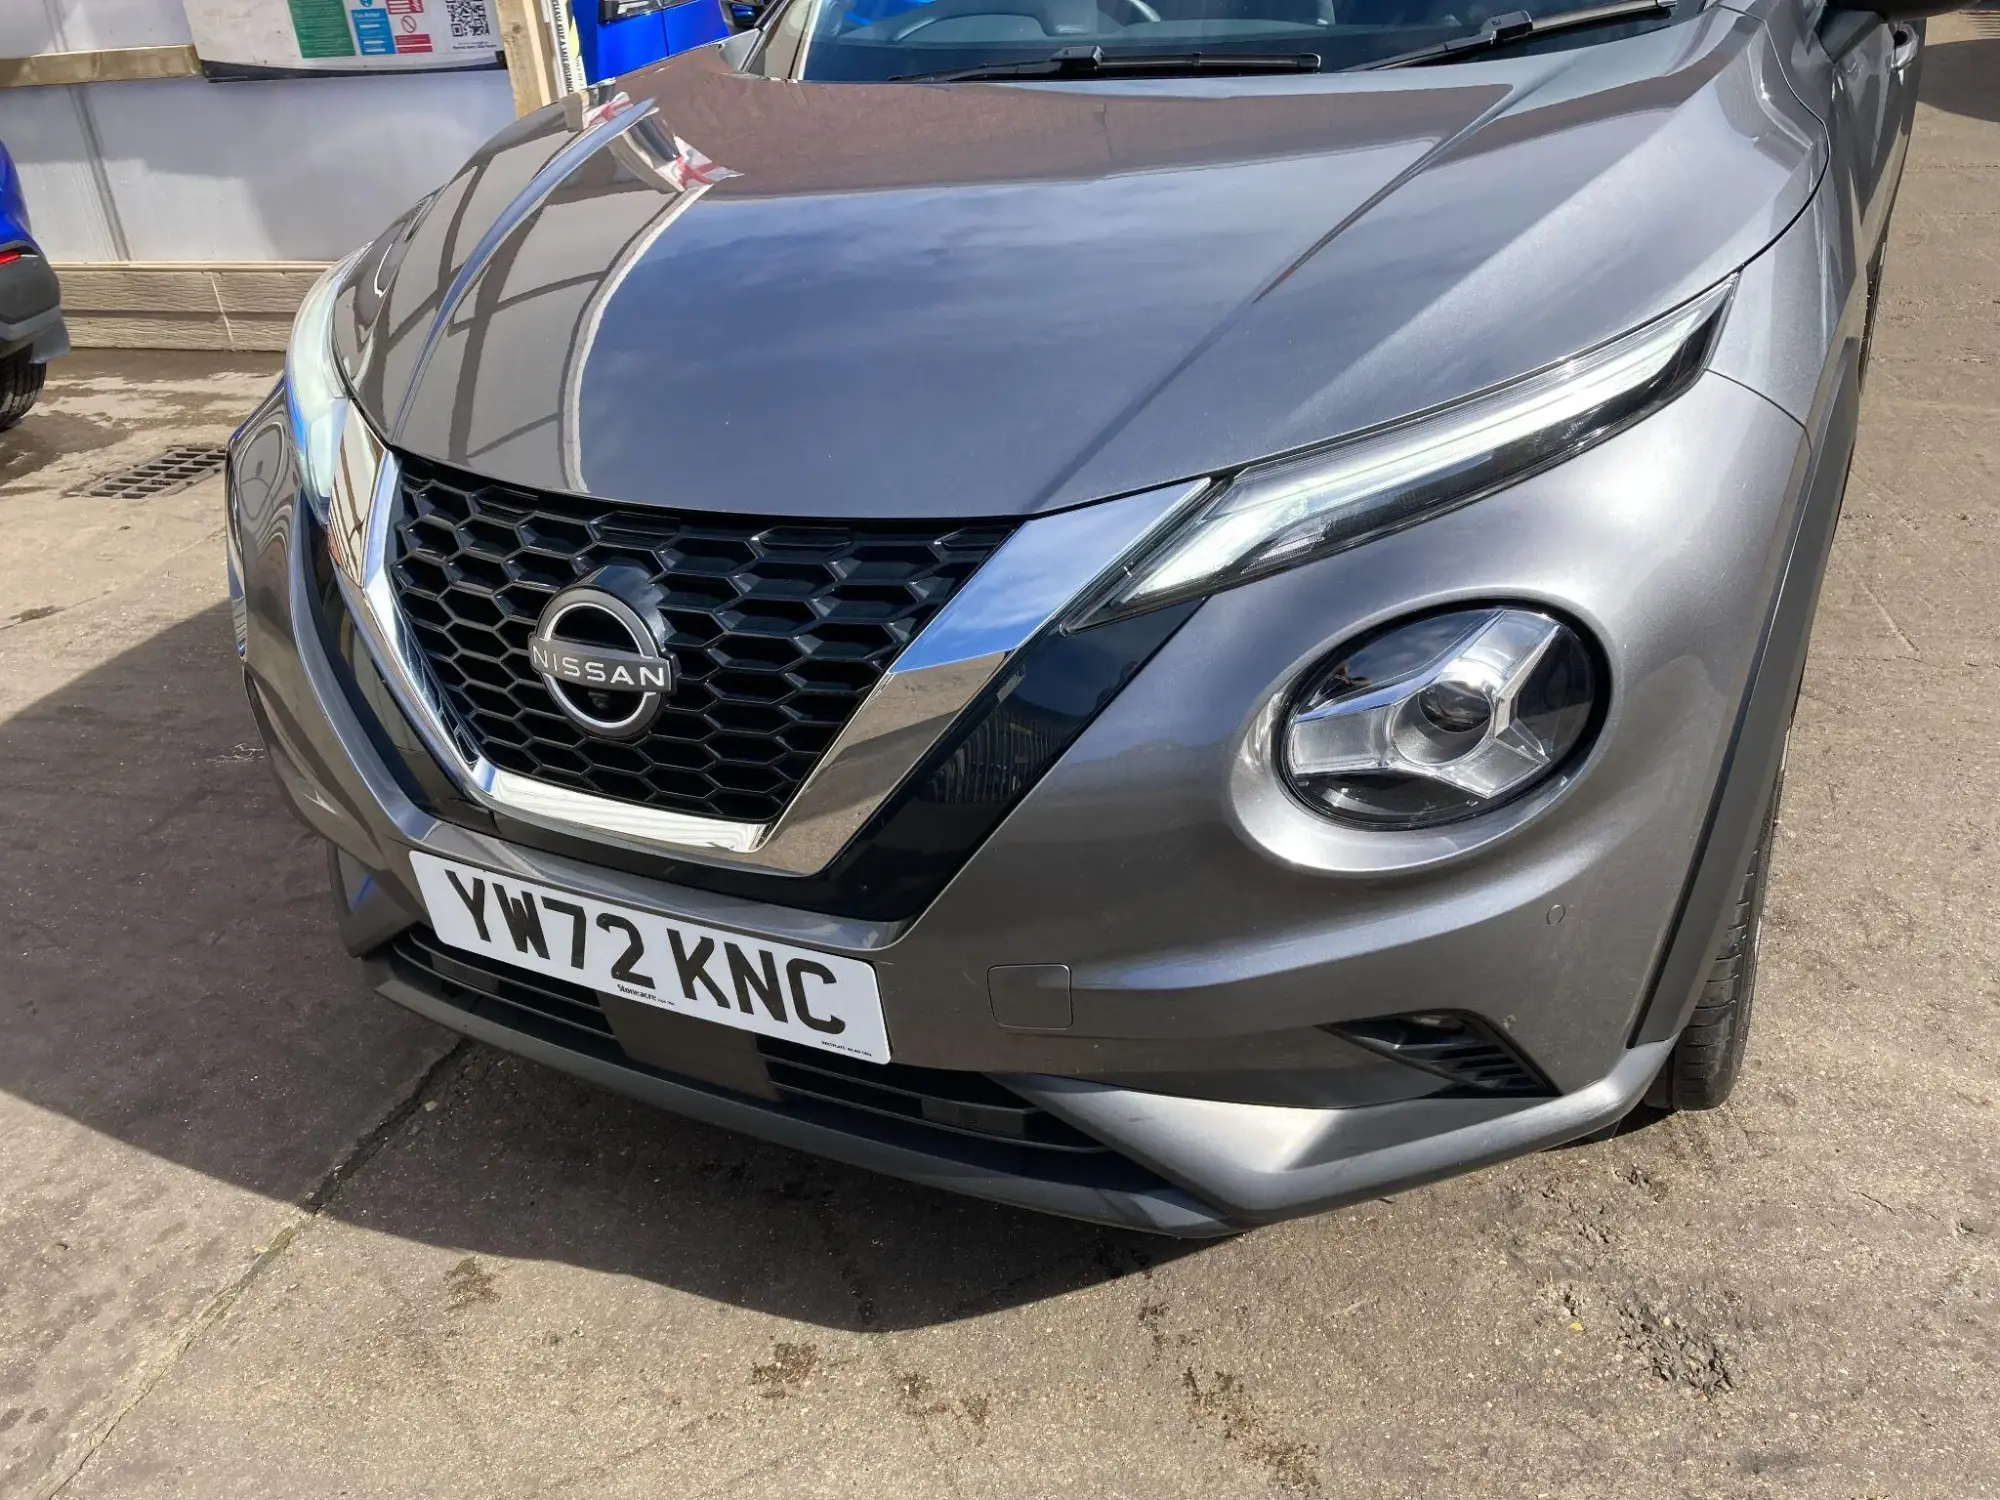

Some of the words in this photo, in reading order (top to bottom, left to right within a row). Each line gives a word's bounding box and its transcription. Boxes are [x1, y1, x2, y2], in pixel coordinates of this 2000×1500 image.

[532, 645, 665, 687] NISSAN
[444, 868, 656, 989] YW72
[666, 927, 847, 1035] KNC
[617, 983, 657, 1002] Stoneacre
